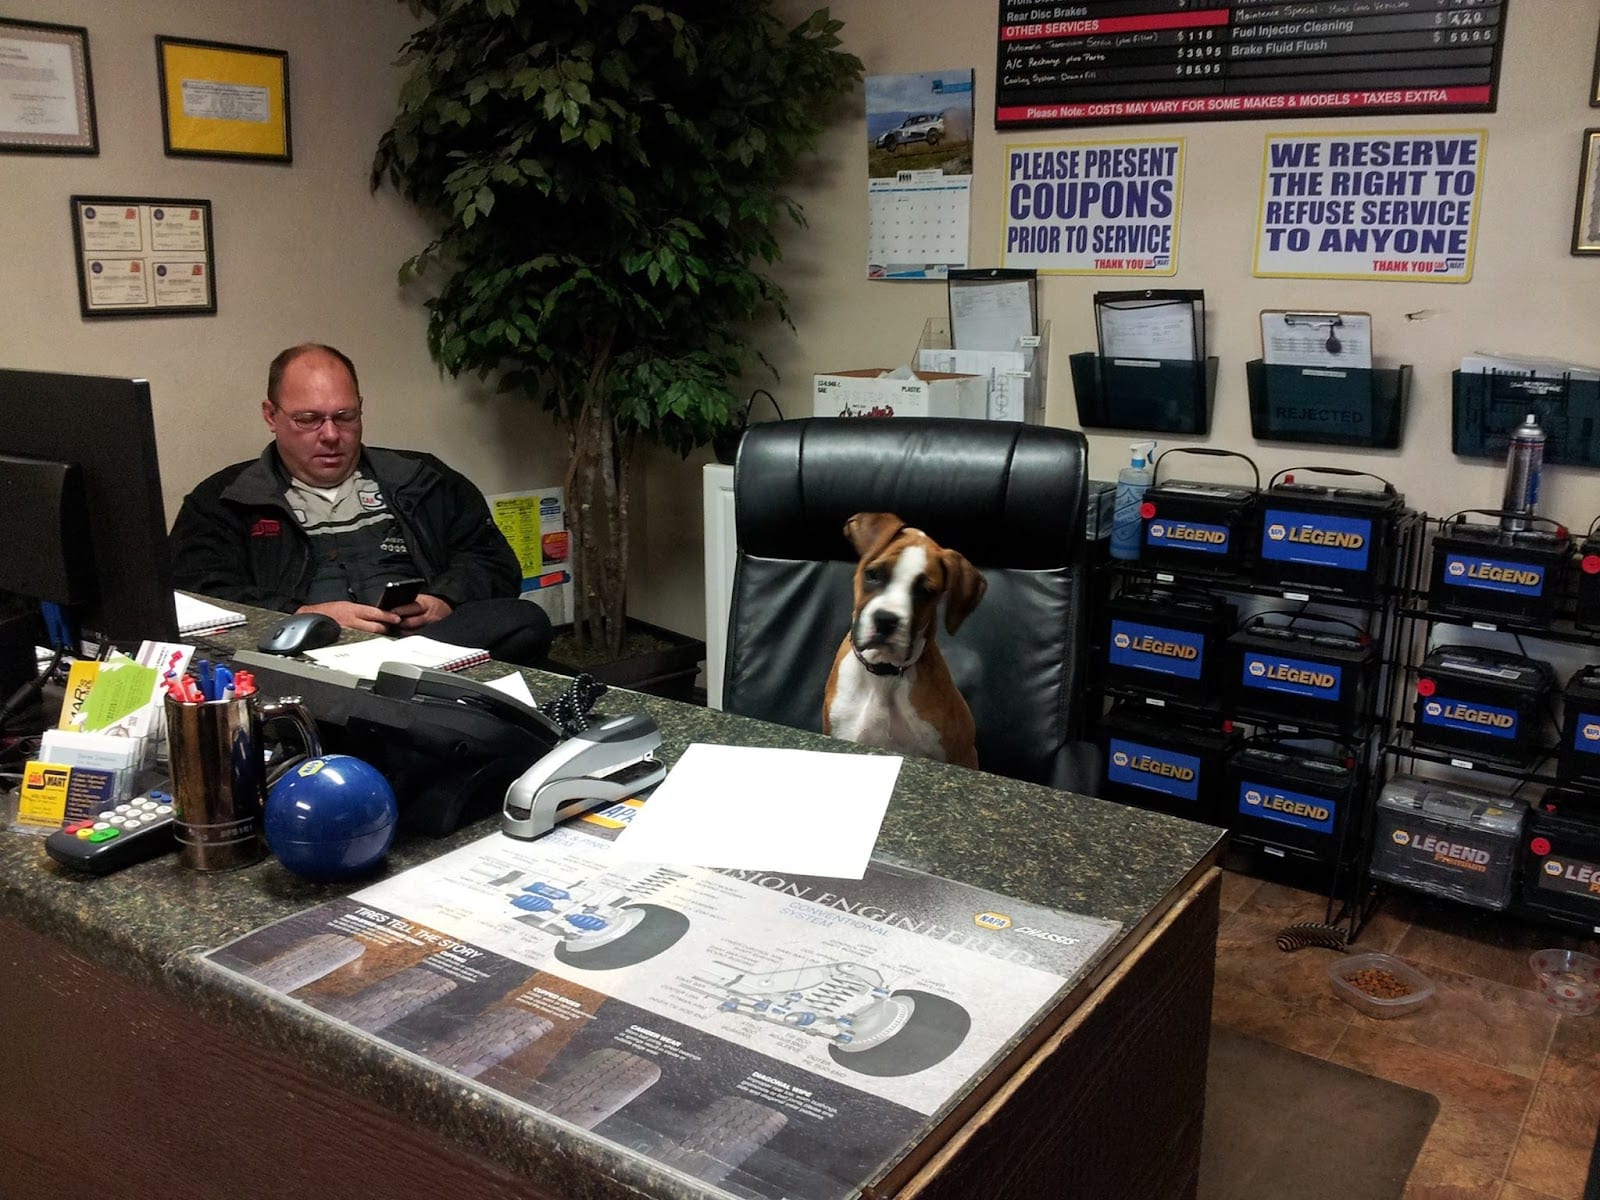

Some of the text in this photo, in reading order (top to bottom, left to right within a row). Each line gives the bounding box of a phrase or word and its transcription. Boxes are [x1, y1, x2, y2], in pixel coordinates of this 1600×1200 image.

[1007, 6, 1087, 22] Rear Disc Brakes
[1007, 20, 1099, 36] OTHER SERVICES
[1232, 20, 1354, 38] Fuel Injector Cleaning
[1231, 40, 1327, 56] Brake Fluid Flush
[1005, 58, 1022, 70] A/C
[1027, 90, 1447, 118] Please Note: COSTS MAY VARY FOR SOME MAKES & MODELS TAXES EXTRA
[1010, 147, 1178, 181] PLEASE PRESENT
[1271, 140, 1477, 168] WE RESERVE
[1269, 170, 1476, 196] THE RIGHT TO
[1010, 179, 1173, 220] COUPONS
[1266, 200, 1471, 226] REFUSE SERVICE
[1007, 224, 1171, 253] PRIOR TO SERVICE
[1266, 228, 1467, 254] TO ANYONE
[1095, 258, 1143, 269] THANK YOU
[1373, 260, 1433, 272] THANK YOU
[1277, 407, 1364, 423] REJECTED
[1166, 526, 1226, 544] LEGEND
[1288, 527, 1364, 550] LEGEND
[1467, 564, 1540, 587] LEGEND
[1132, 638, 1197, 660] LEGEND
[1267, 665, 1335, 688] LEGEND
[1444, 706, 1513, 728] LEGEND
[1130, 756, 1195, 782] LEGEND
[600, 805, 637, 823] AP
[1263, 796, 1329, 821] LEGEND
[1411, 836, 1490, 865] LEGEND
[1433, 854, 1487, 873] Premium
[780, 908, 834, 929] SYSTEM
[789, 902, 890, 937] CONVENTIONAL
[979, 913, 1079, 945] NAPA CHASSIS
[355, 907, 390, 923] TIRES
[387, 919, 414, 934] TELL
[414, 930, 441, 944] THE
[439, 938, 484, 959] STORY
[752, 1071, 791, 1090] DIAGONAL
